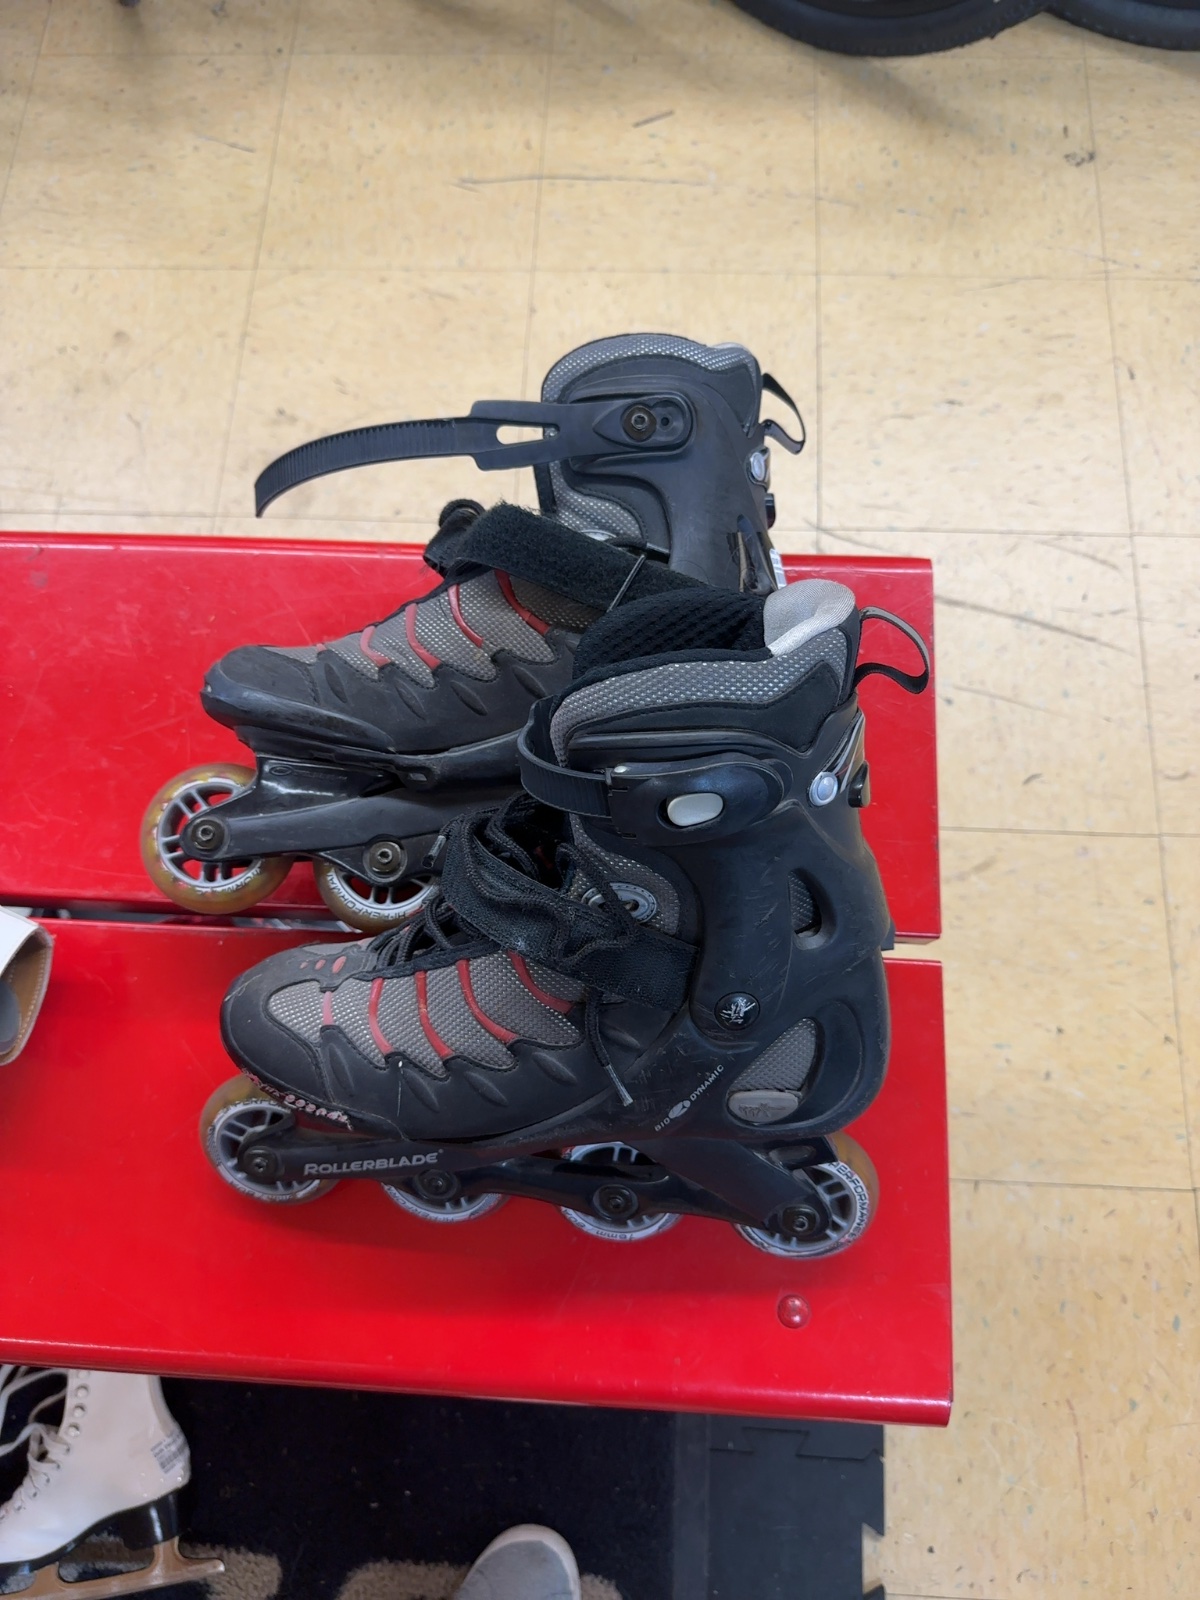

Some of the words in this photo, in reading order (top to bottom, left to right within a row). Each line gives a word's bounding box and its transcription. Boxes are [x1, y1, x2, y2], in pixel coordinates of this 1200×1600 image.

[654, 1117, 671, 1132] BIO
[689, 1064, 724, 1102] DYNAMIC
[303, 1152, 439, 1176] ROLLERBLADE
